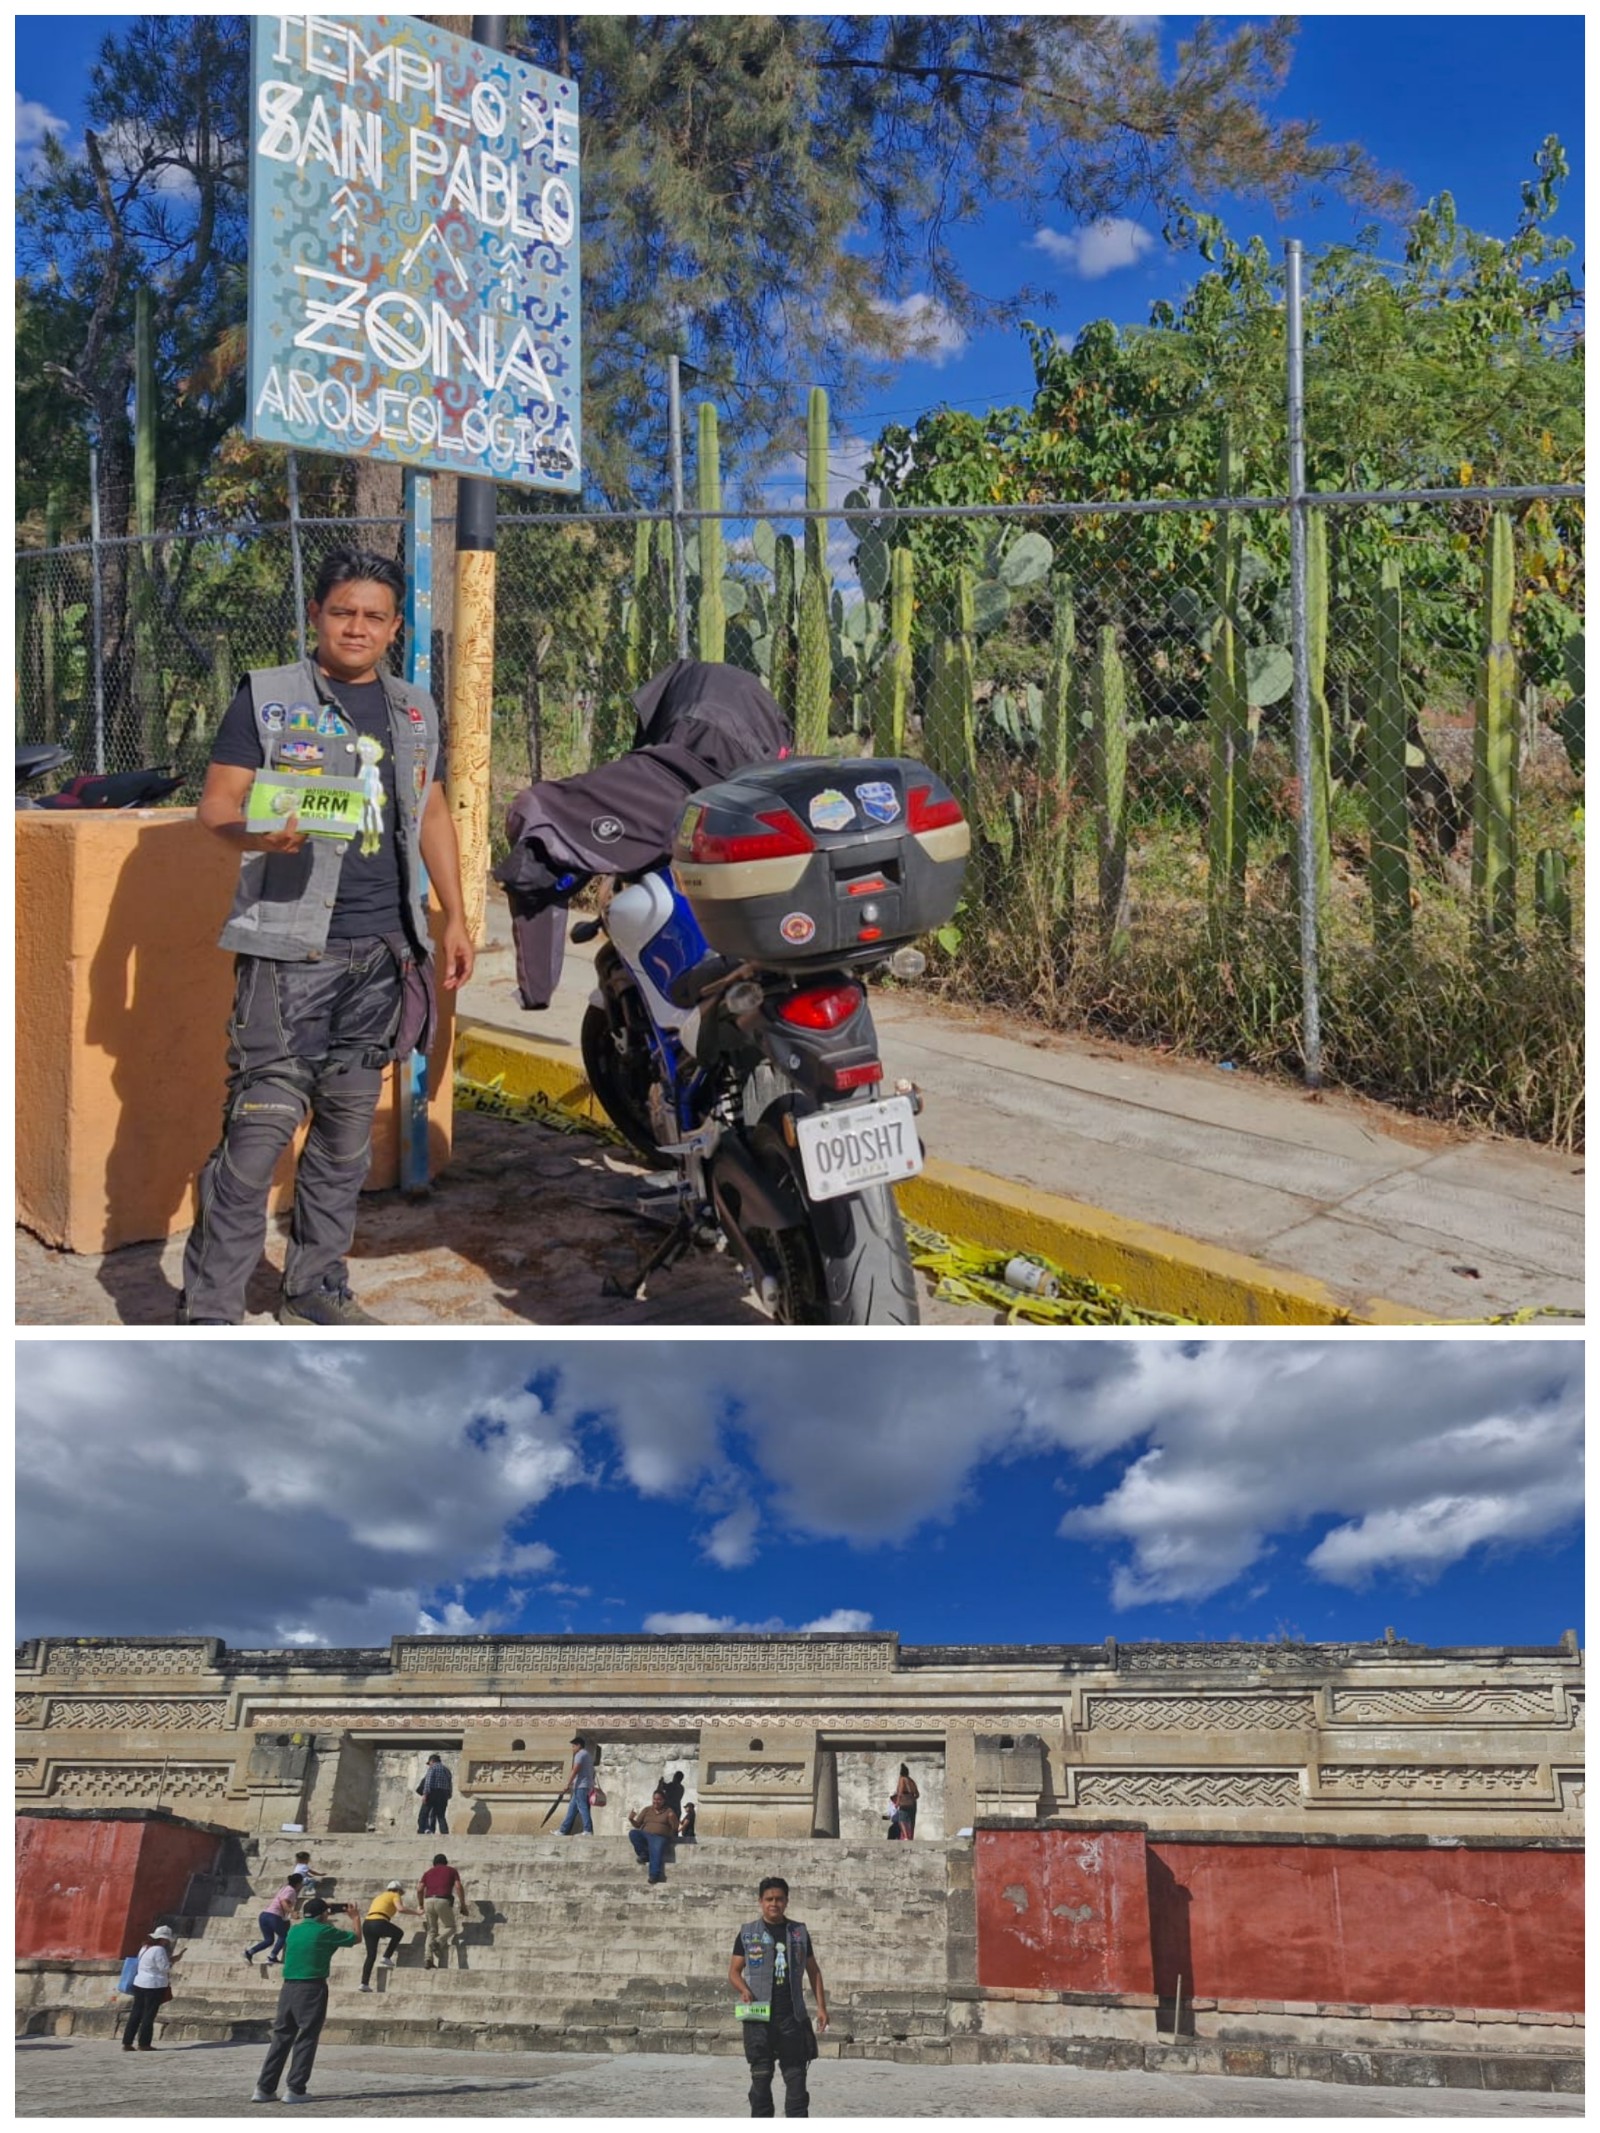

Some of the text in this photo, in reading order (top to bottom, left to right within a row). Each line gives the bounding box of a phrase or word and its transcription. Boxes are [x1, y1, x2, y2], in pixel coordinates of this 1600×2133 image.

[272, 15, 579, 166] TEMPLO DE
[257, 79, 576, 246] SAN PABLO
[293, 264, 556, 402] ZONA
[301, 794, 349, 815] RRM
[815, 1121, 904, 1174] 09DSH7
